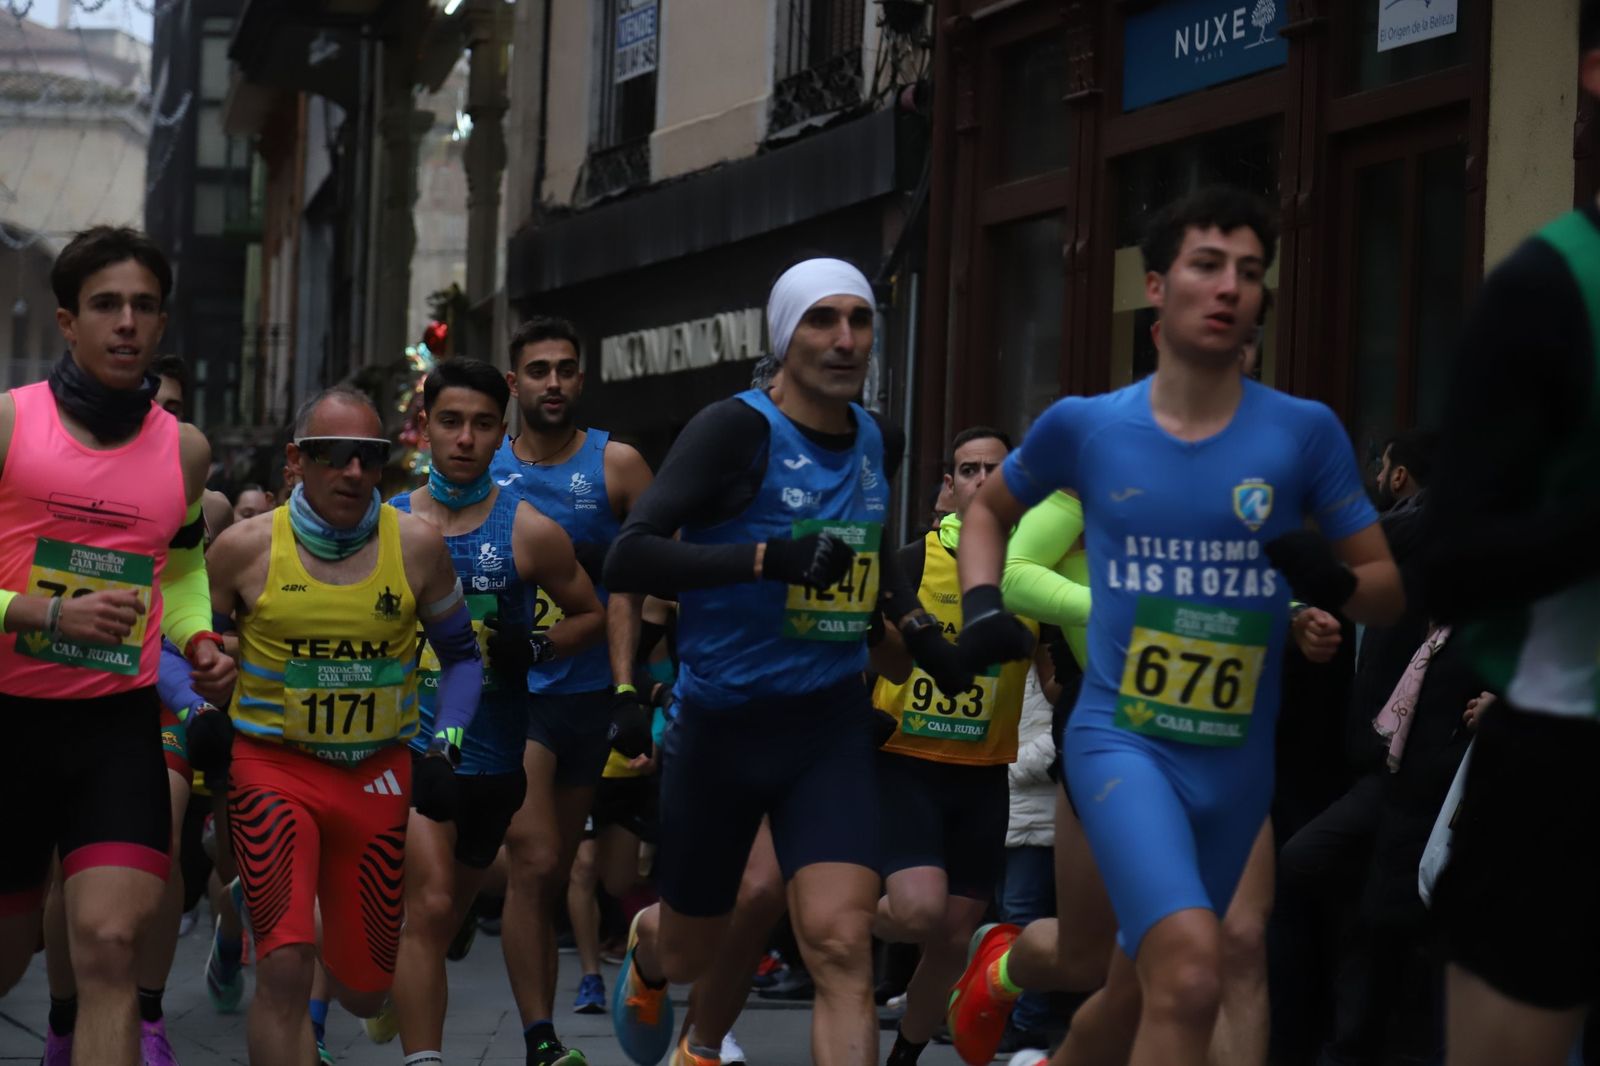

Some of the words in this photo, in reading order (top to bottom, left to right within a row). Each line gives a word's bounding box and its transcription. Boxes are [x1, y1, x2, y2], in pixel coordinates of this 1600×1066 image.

[1175, 7, 1246, 59] NUXE
[1380, 29, 1387, 42] El
[1388, 25, 1411, 41] Origen
[1411, 20, 1420, 33] de
[1422, 18, 1429, 30] la
[1430, 14, 1455, 29] Belleza
[1125, 535, 1260, 562] ATLETISMO
[70, 557, 92, 569] CAJA
[95, 562, 124, 574] RURAL
[281, 584, 308, 592] 42K
[1108, 559, 1164, 593] LAS
[1174, 566, 1277, 597] ROZAS
[817, 620, 846, 632] CAJA
[52, 642, 84, 658] CAJA
[88, 647, 132, 666] RURAL
[284, 639, 389, 658] TEAM
[318, 673, 340, 682] CAJA
[342, 673, 373, 682] RURAL
[1136, 645, 1243, 709] 676
[911, 677, 984, 717] 933
[302, 692, 376, 735] 1171
[1155, 713, 1195, 732] CAJA
[927, 721, 952, 733] CAJA
[954, 724, 985, 736] RURAL
[316, 750, 349, 761] CAJA
